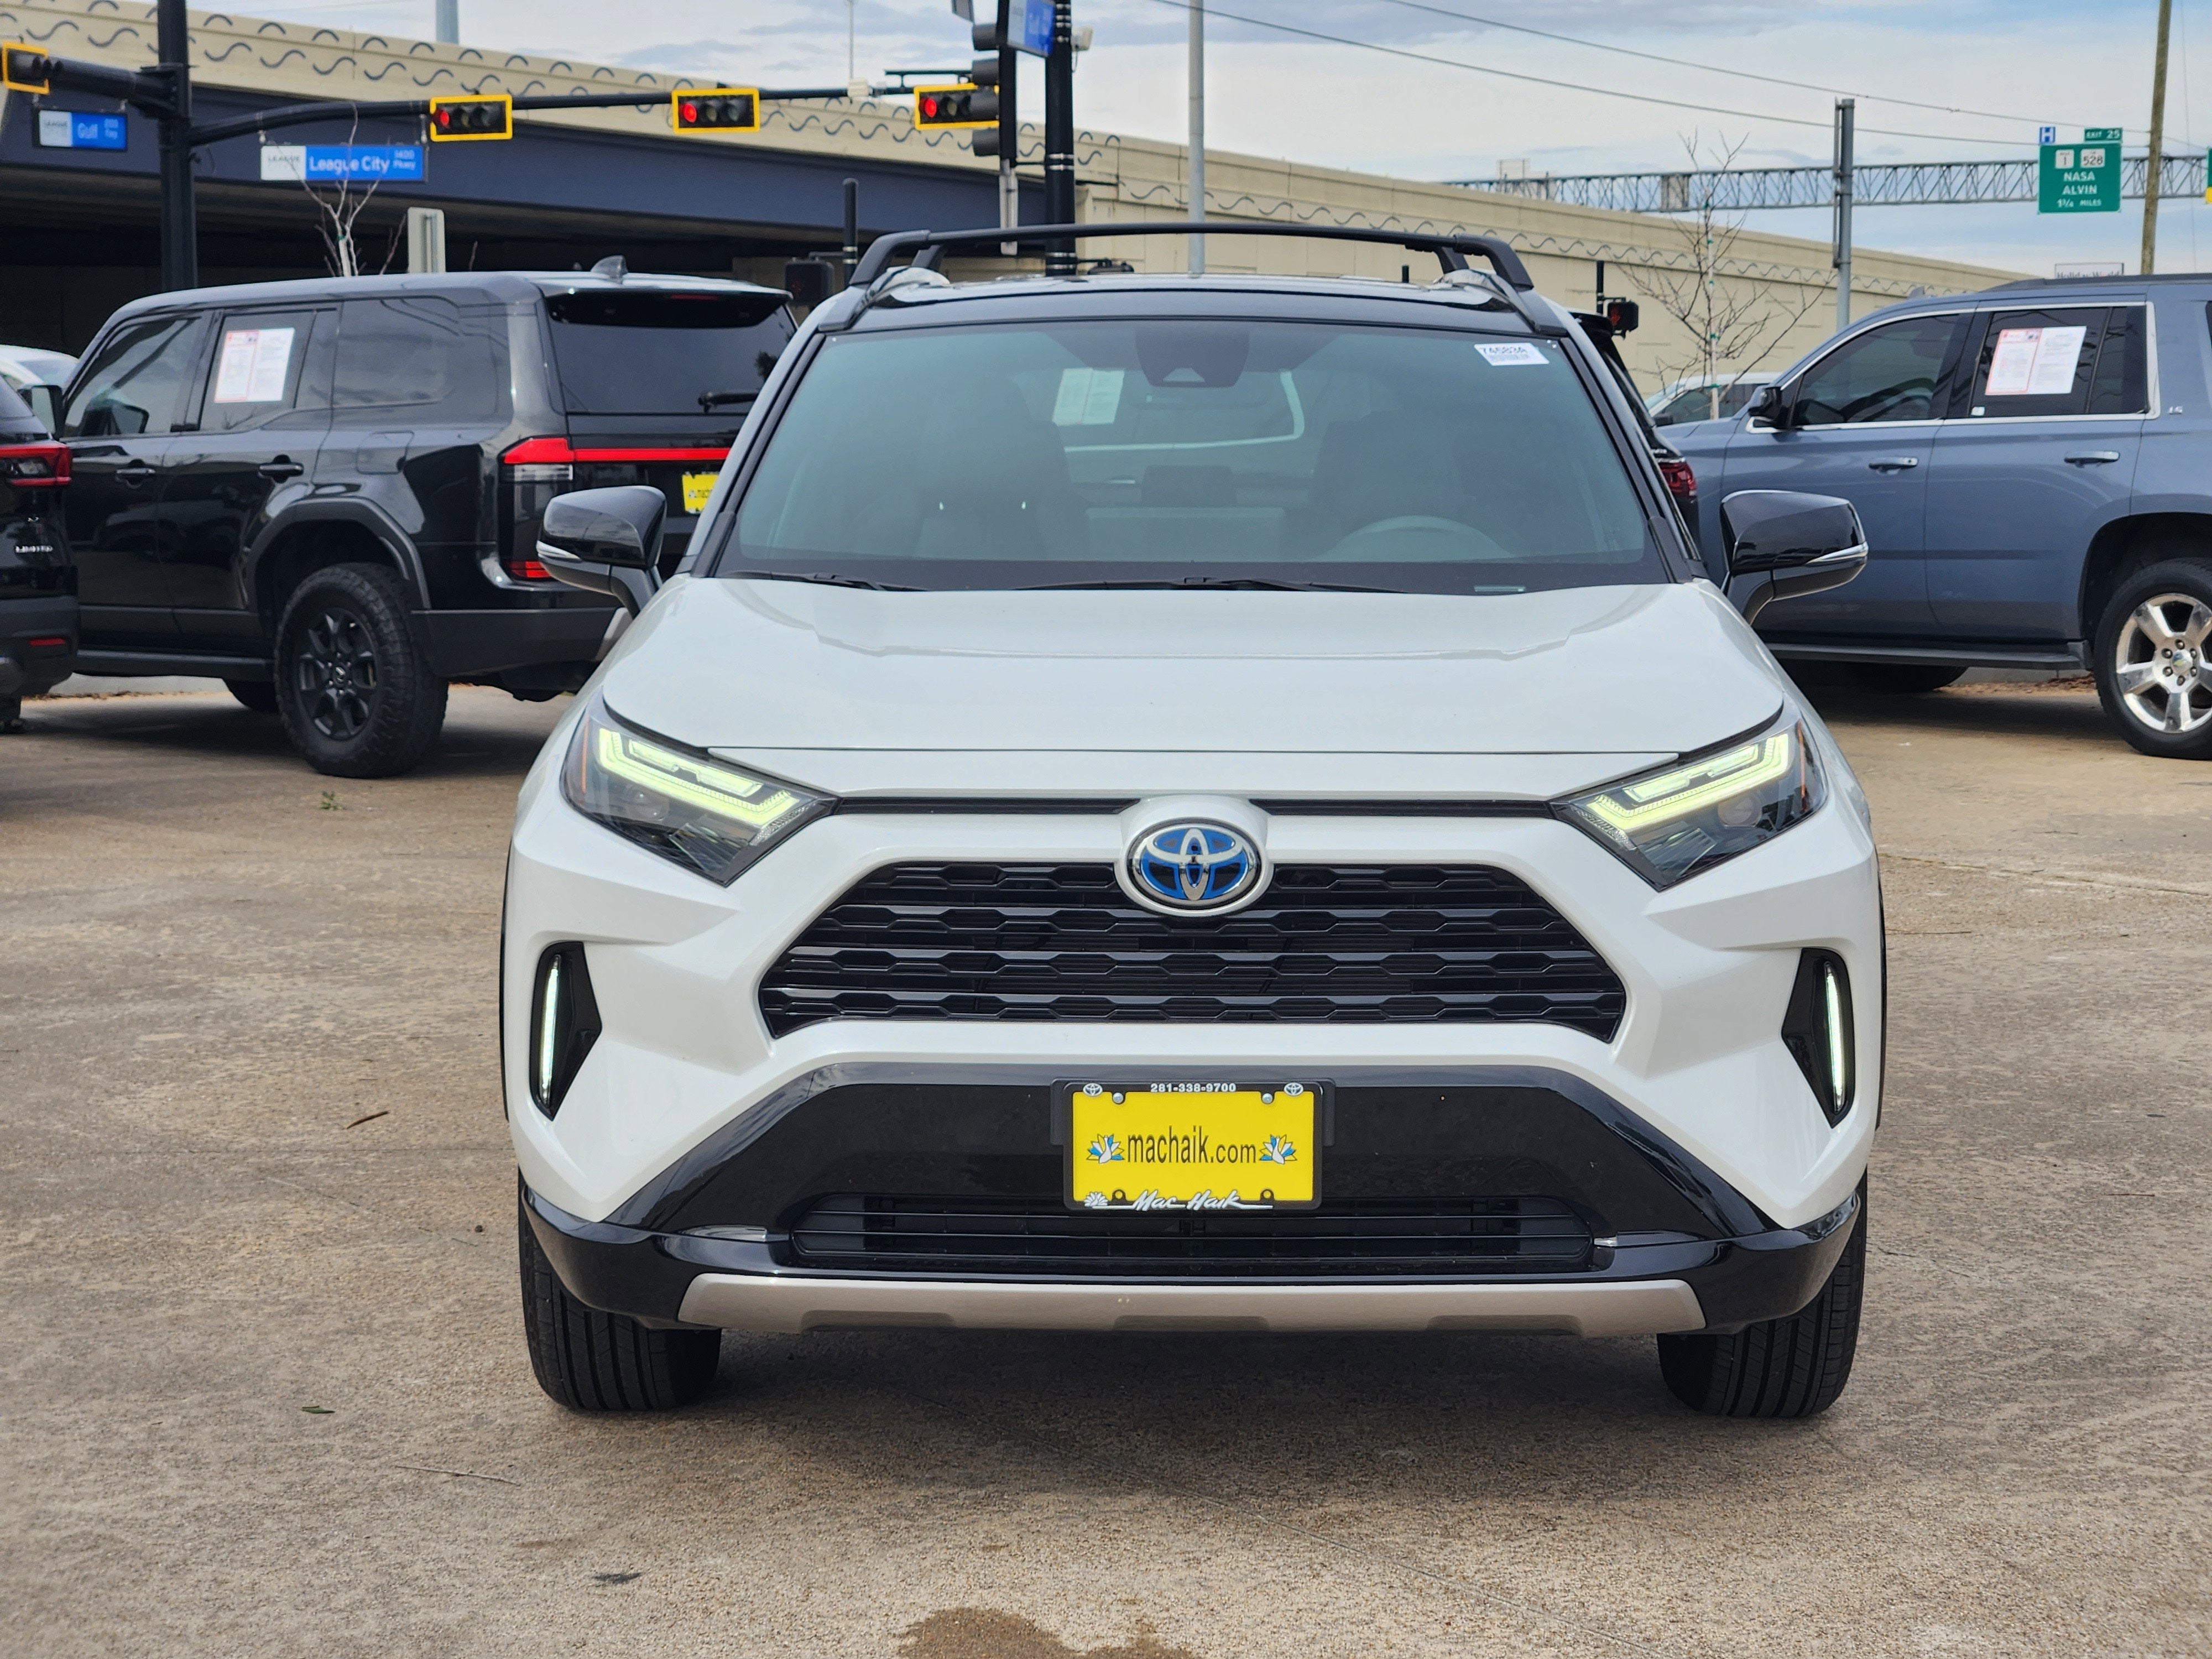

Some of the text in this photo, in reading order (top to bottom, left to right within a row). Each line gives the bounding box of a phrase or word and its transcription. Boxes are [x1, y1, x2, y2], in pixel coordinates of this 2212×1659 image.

[2106, 129, 2120, 139] 25
[309, 155, 390, 175] League City
[2083, 155, 2103, 166] 528
[2063, 171, 2096, 181] NASA
[2062, 185, 2098, 195] ALVIN
[1150, 1082, 1237, 1093] 281-338-9700
[1127, 1125, 1256, 1164] machaik.com
[1131, 1189, 1254, 1212] Mac Haik
